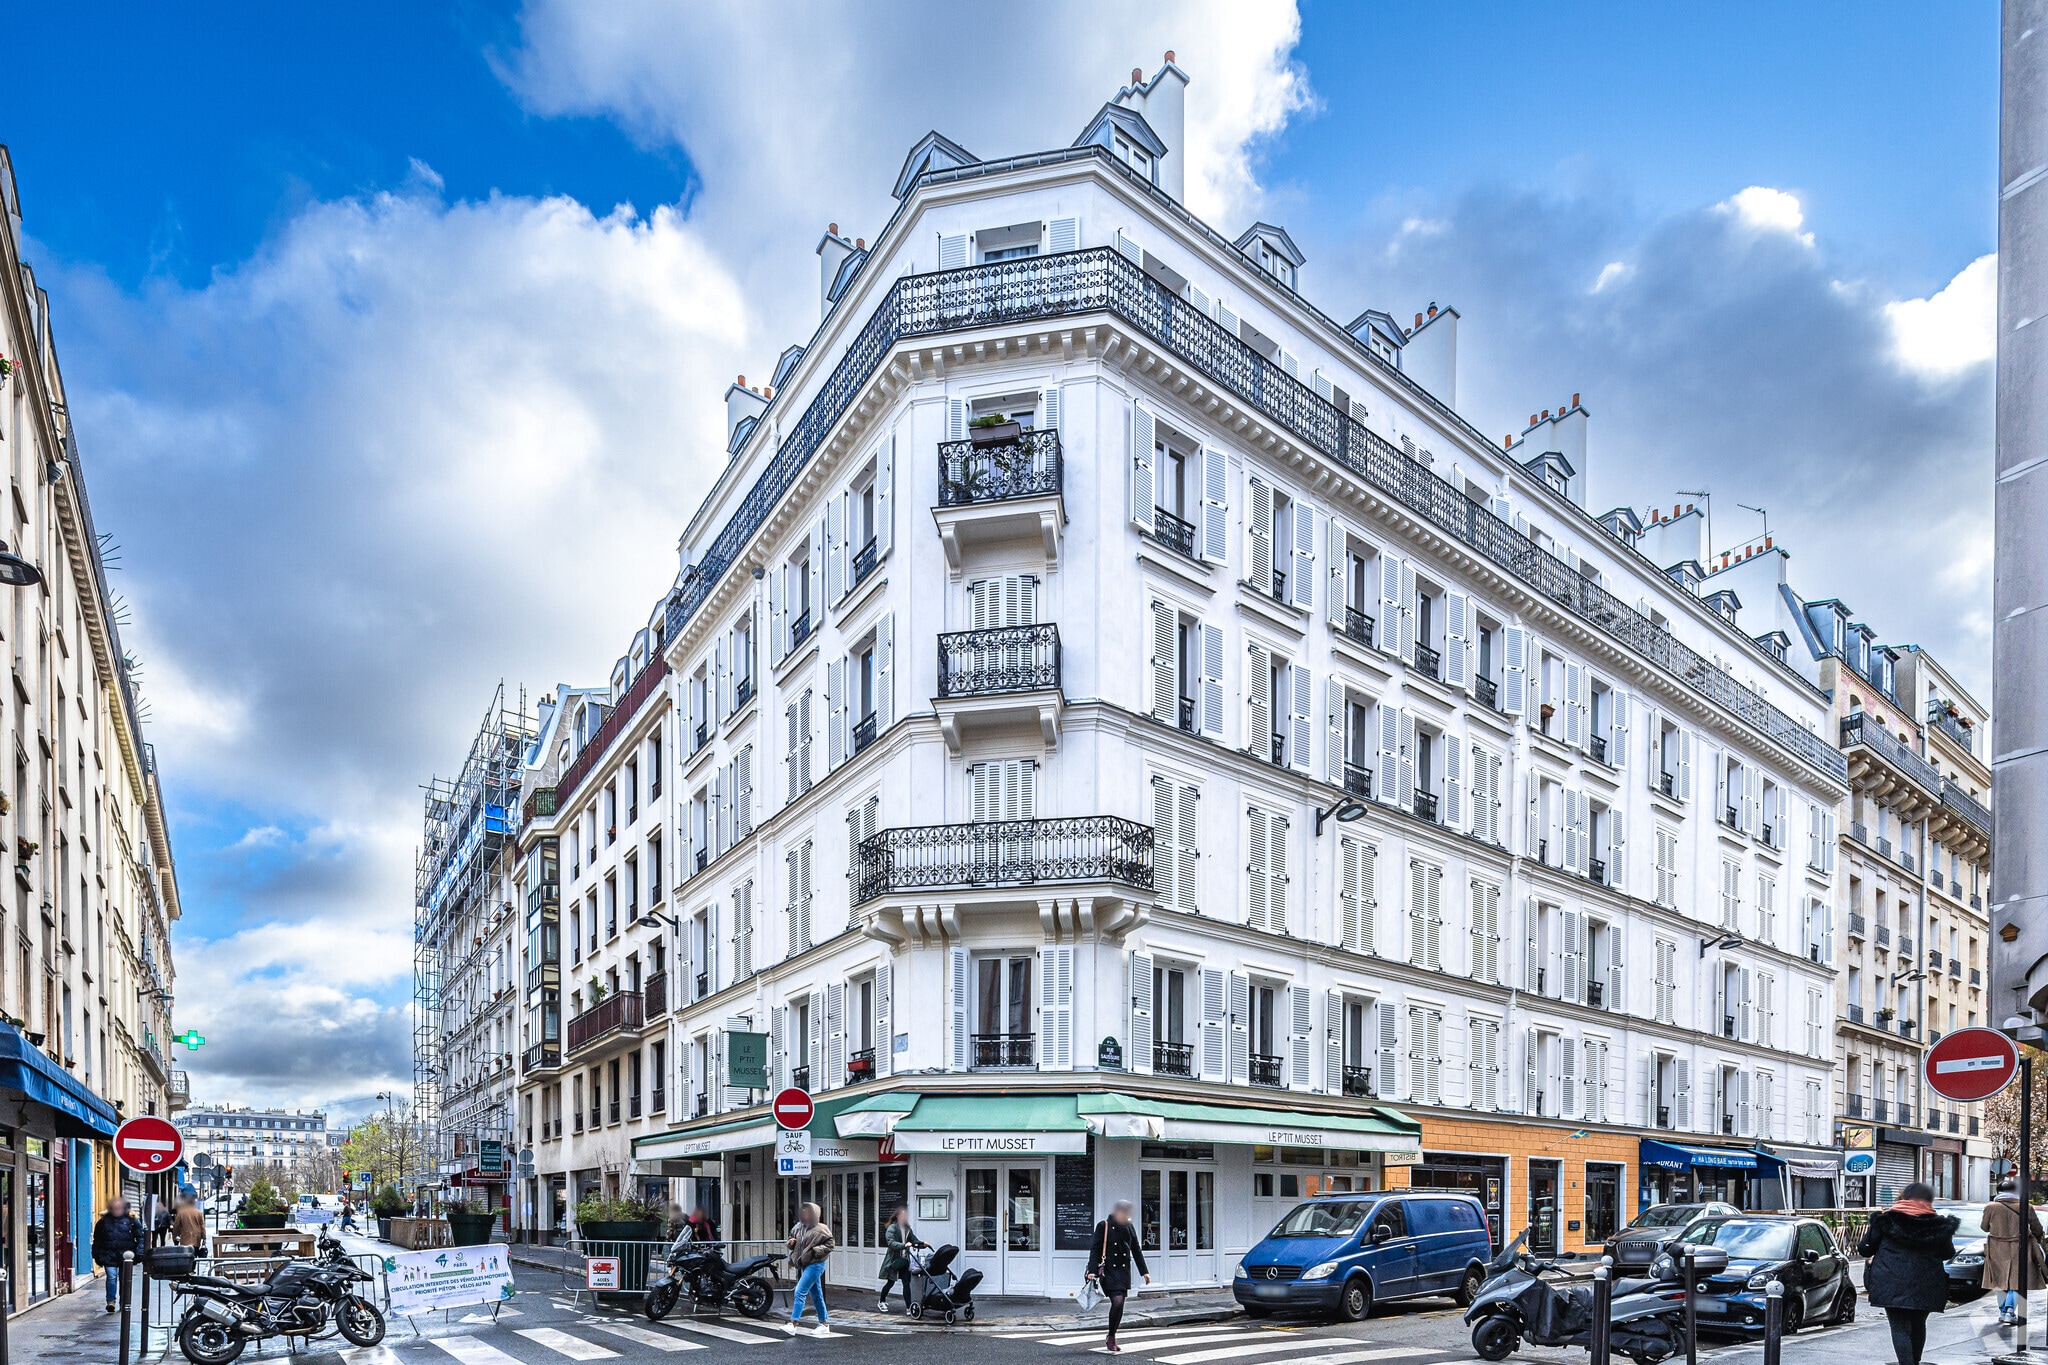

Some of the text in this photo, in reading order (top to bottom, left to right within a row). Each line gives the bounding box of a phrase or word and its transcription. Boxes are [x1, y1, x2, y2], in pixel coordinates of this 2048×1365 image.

[743, 1045, 751, 1054] LE
[739, 1055, 756, 1064] P'TIT
[733, 1067, 762, 1076] MUSSET
[1268, 1131, 1323, 1145] LE P'TIT MUSSET
[942, 1138, 1036, 1150] LE P'TIT MUSSET
[818, 1147, 849, 1157] BISTROT
[1705, 1156, 1717, 1165] LONG
[1717, 1157, 1727, 1165] BAIE
[390, 1283, 425, 1293] CIRCULATION
[425, 1279, 450, 1288] INTERDITE
[450, 1278, 459, 1286] DES
